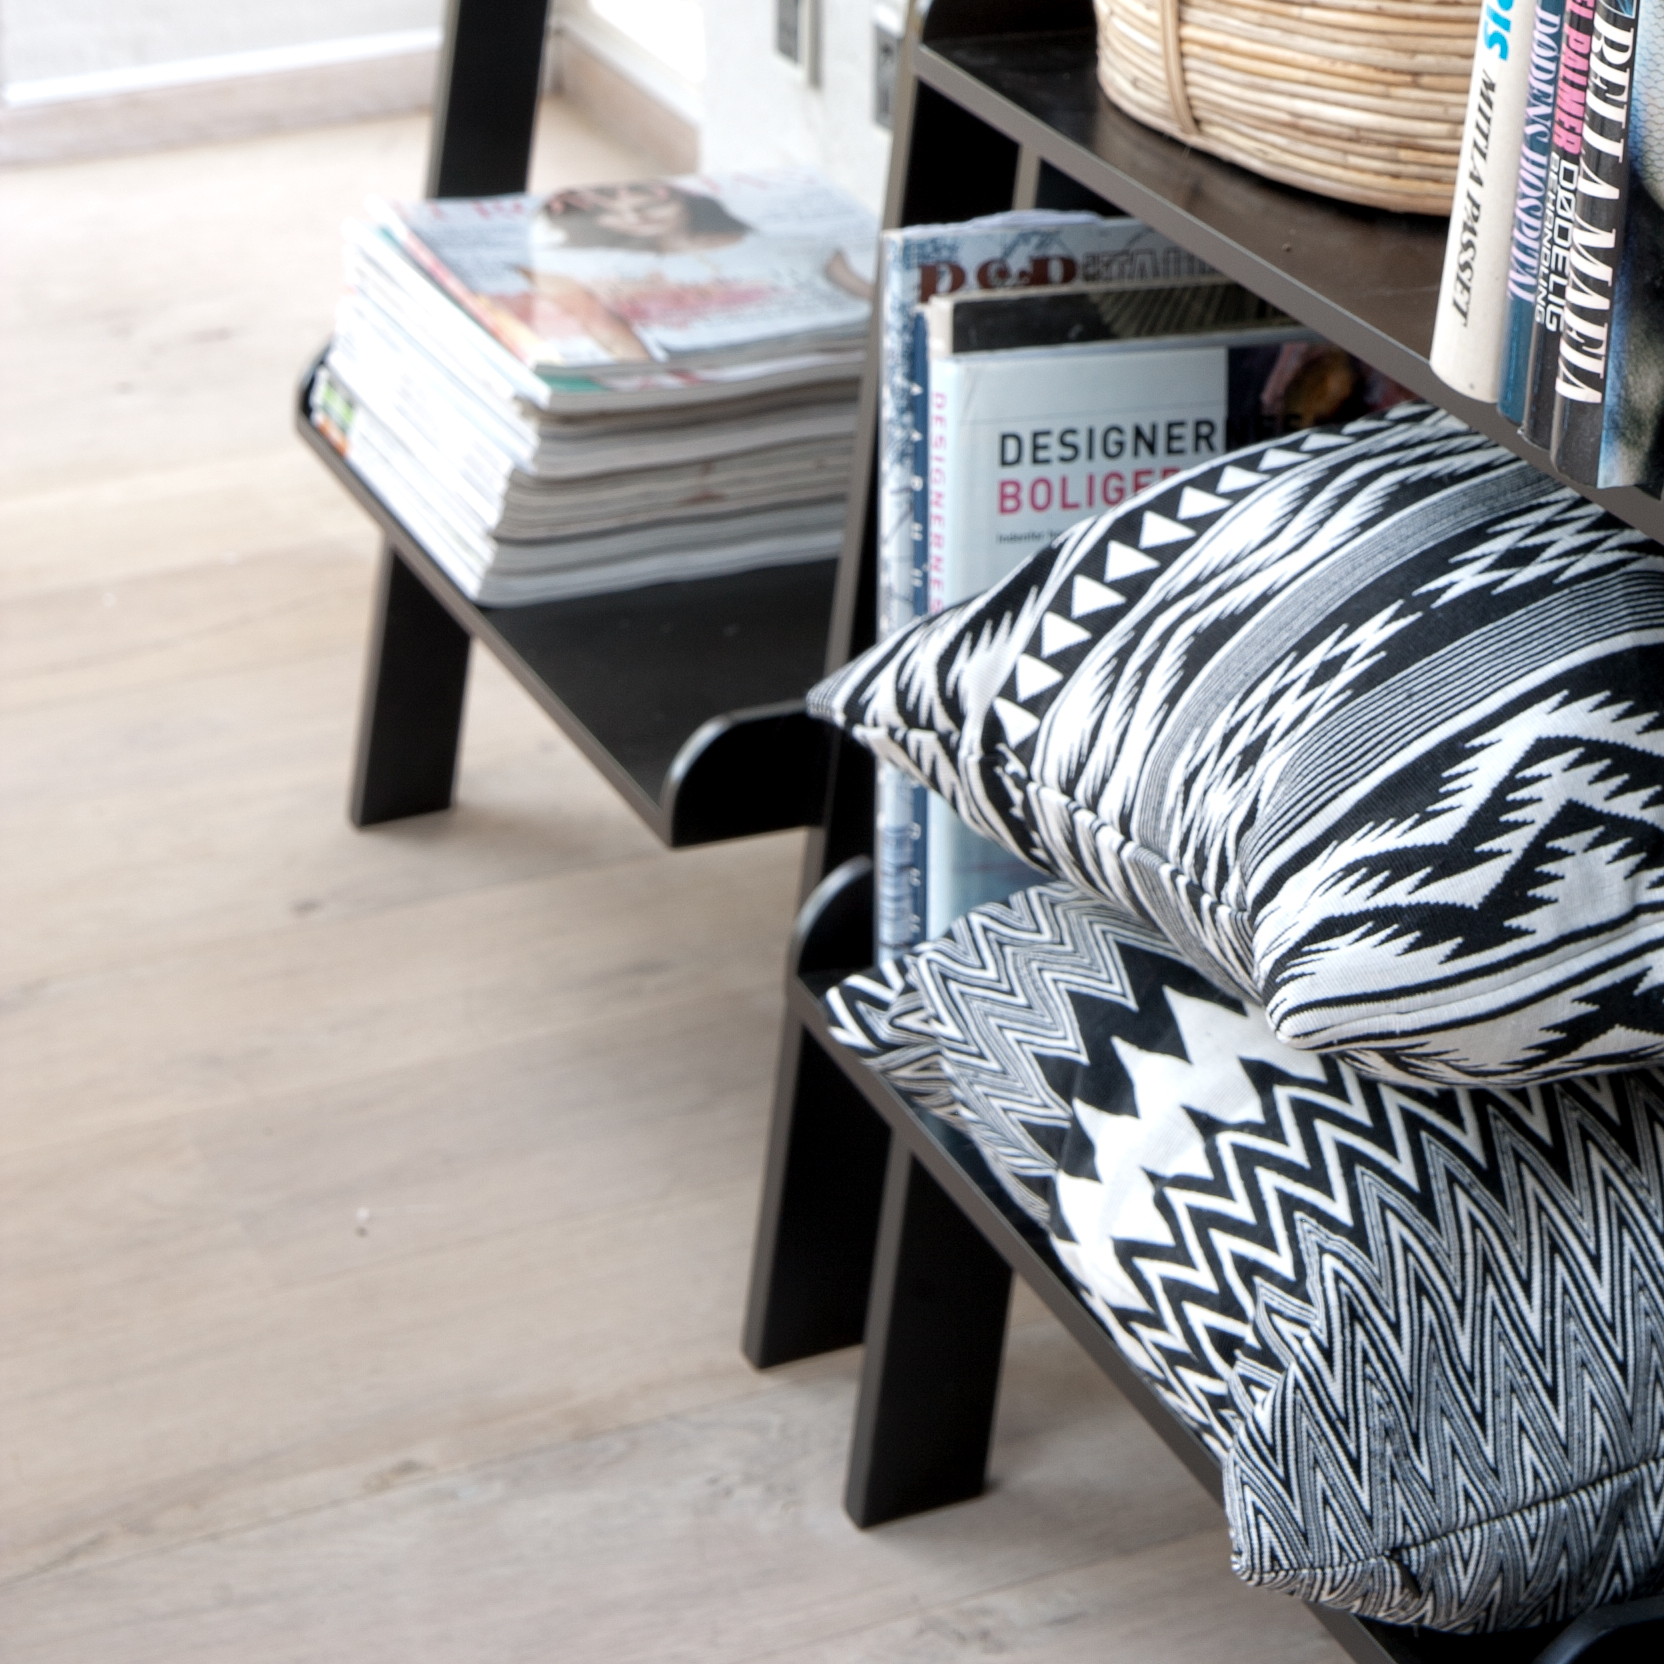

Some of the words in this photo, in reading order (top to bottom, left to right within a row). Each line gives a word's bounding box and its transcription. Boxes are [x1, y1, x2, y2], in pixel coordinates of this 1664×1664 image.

[1467, 67, 1498, 188] MITLA
[1552, 19, 1592, 156] PALMER
[1451, 189, 1482, 329] PASSET
[1535, 150, 1560, 325] BEHANDLING
[1545, 158, 1580, 334] DØDELIG
[1555, 212, 1617, 405] MAFIA
[999, 468, 1185, 515] BOLIGE
